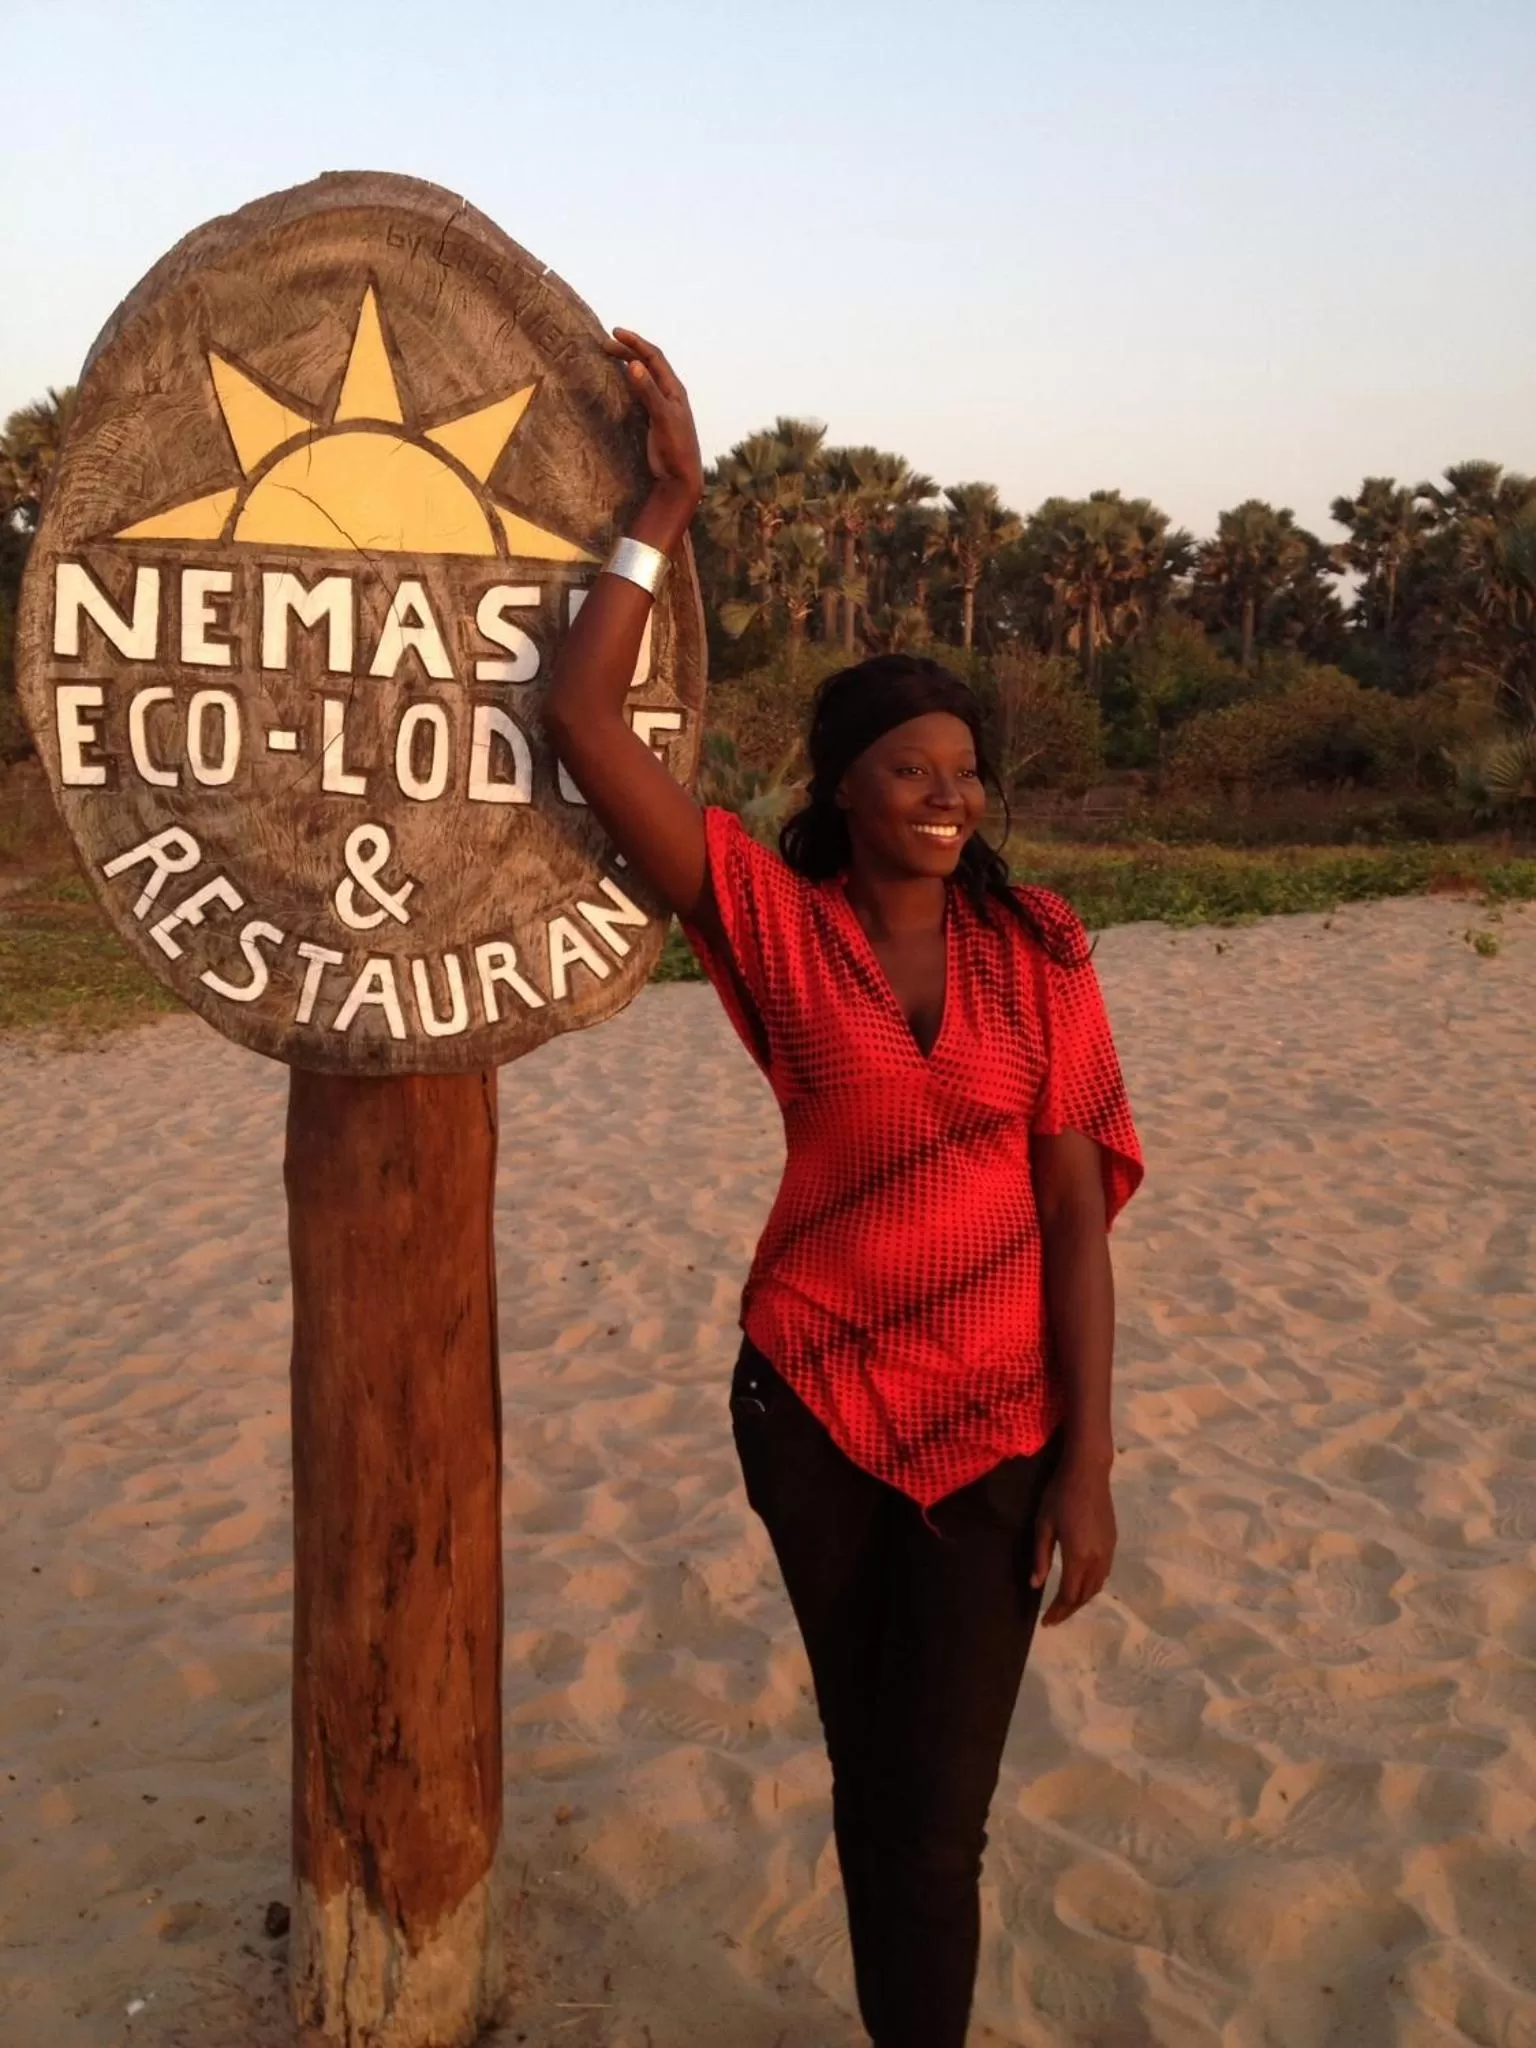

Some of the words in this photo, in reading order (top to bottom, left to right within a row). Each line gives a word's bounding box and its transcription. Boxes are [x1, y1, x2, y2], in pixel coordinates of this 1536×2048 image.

[53, 562, 653, 688] NEMAS
[56, 685, 685, 804] ECO-LOD
[103, 826, 650, 1040] RESTAURAN
[335, 823, 418, 930] &
